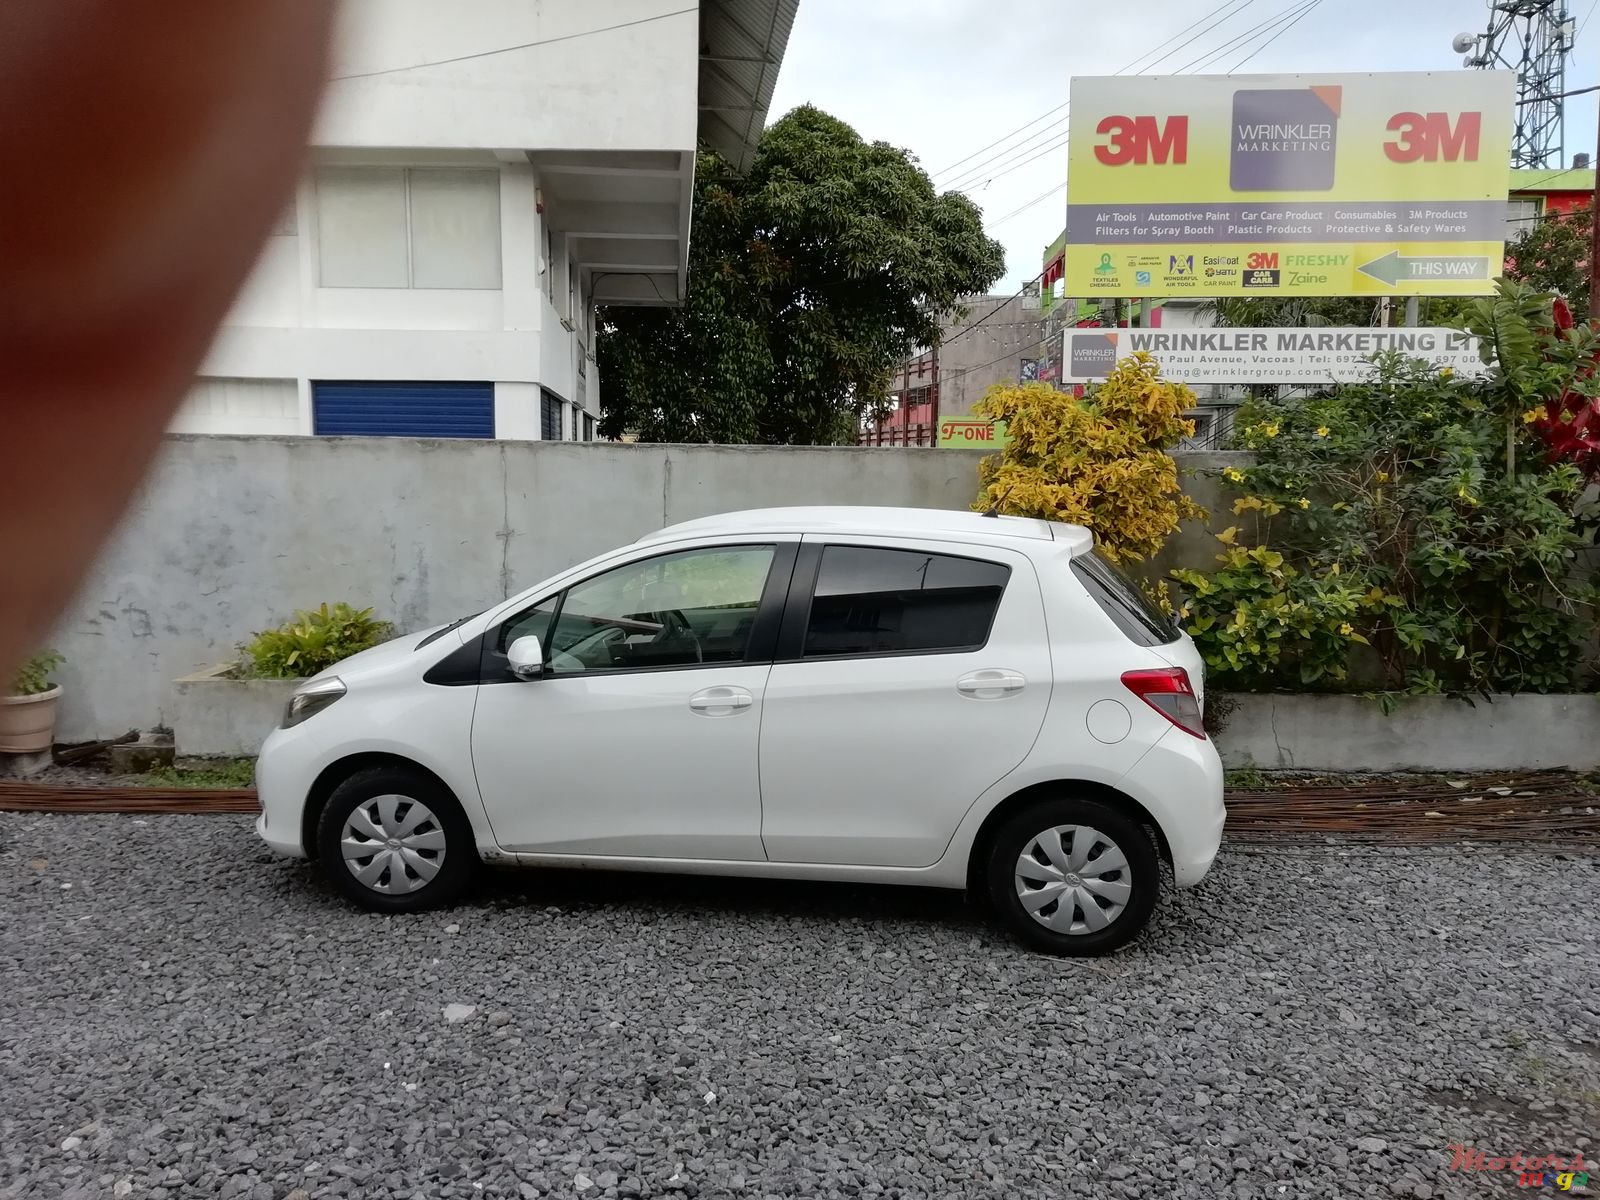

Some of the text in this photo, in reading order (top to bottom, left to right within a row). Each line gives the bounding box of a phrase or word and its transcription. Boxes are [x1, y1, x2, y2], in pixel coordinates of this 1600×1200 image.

[1238, 124, 1331, 140] WRINKLER
[1383, 111, 1482, 164] 3M
[1094, 115, 1189, 167] 3M
[1237, 141, 1330, 152] MARKETING
[1096, 212, 1137, 222] Air Tools
[1148, 211, 1230, 222] Automotive Paint
[1241, 211, 1323, 221] Car Care Product
[1334, 210, 1397, 220] Consumables
[1409, 210, 1468, 220] 3M Products
[1096, 225, 1214, 237] Filters for Spray Booth
[1228, 225, 1312, 235] Plastic Products
[1326, 224, 1466, 235] Protective & Safety Wares
[1247, 252, 1279, 270] 3M
[1285, 254, 1350, 266] FRESHY
[1409, 261, 1478, 276] THIS WAY
[1288, 271, 1327, 286] Zaine
[1130, 333, 1268, 351] WRINKLER
[1277, 333, 1435, 351] MARKETING
[1074, 349, 1115, 357] WRINKLER
[1169, 355, 1194, 363] Paul
[1200, 355, 1247, 364] Avenue,
[1252, 355, 1296, 363] Vacoas
[1308, 355, 1332, 363] Tel:
